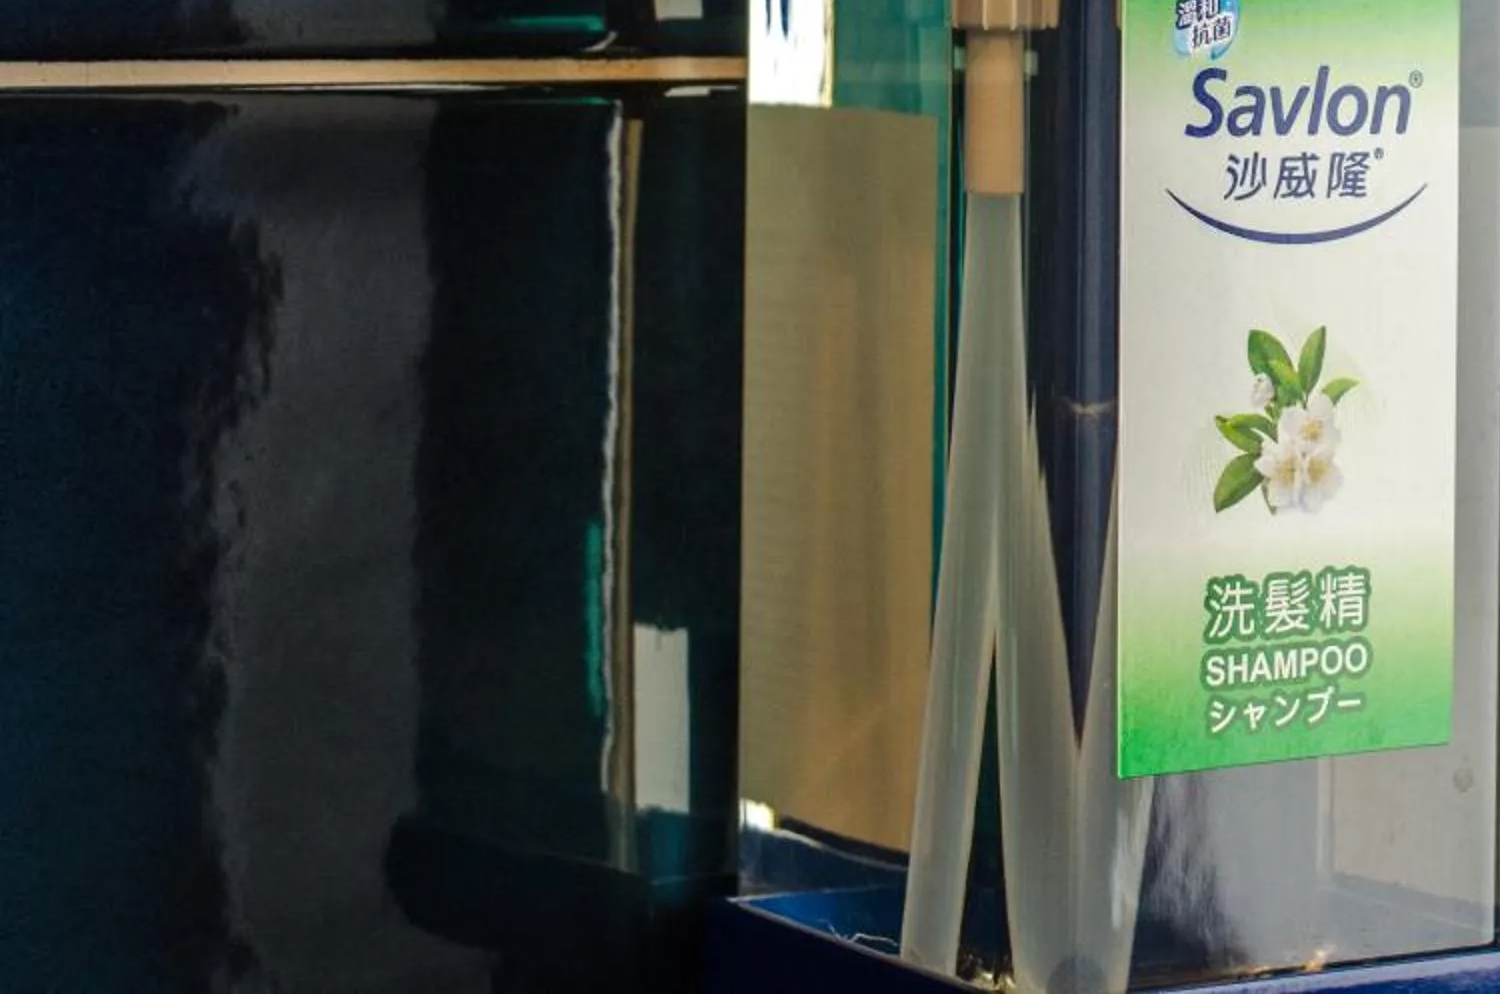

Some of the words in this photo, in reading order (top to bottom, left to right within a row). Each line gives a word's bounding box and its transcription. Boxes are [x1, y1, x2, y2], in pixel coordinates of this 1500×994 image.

[1207, 571, 1367, 639] 洗髮精
[1205, 642, 1369, 687] SHAMPOO
